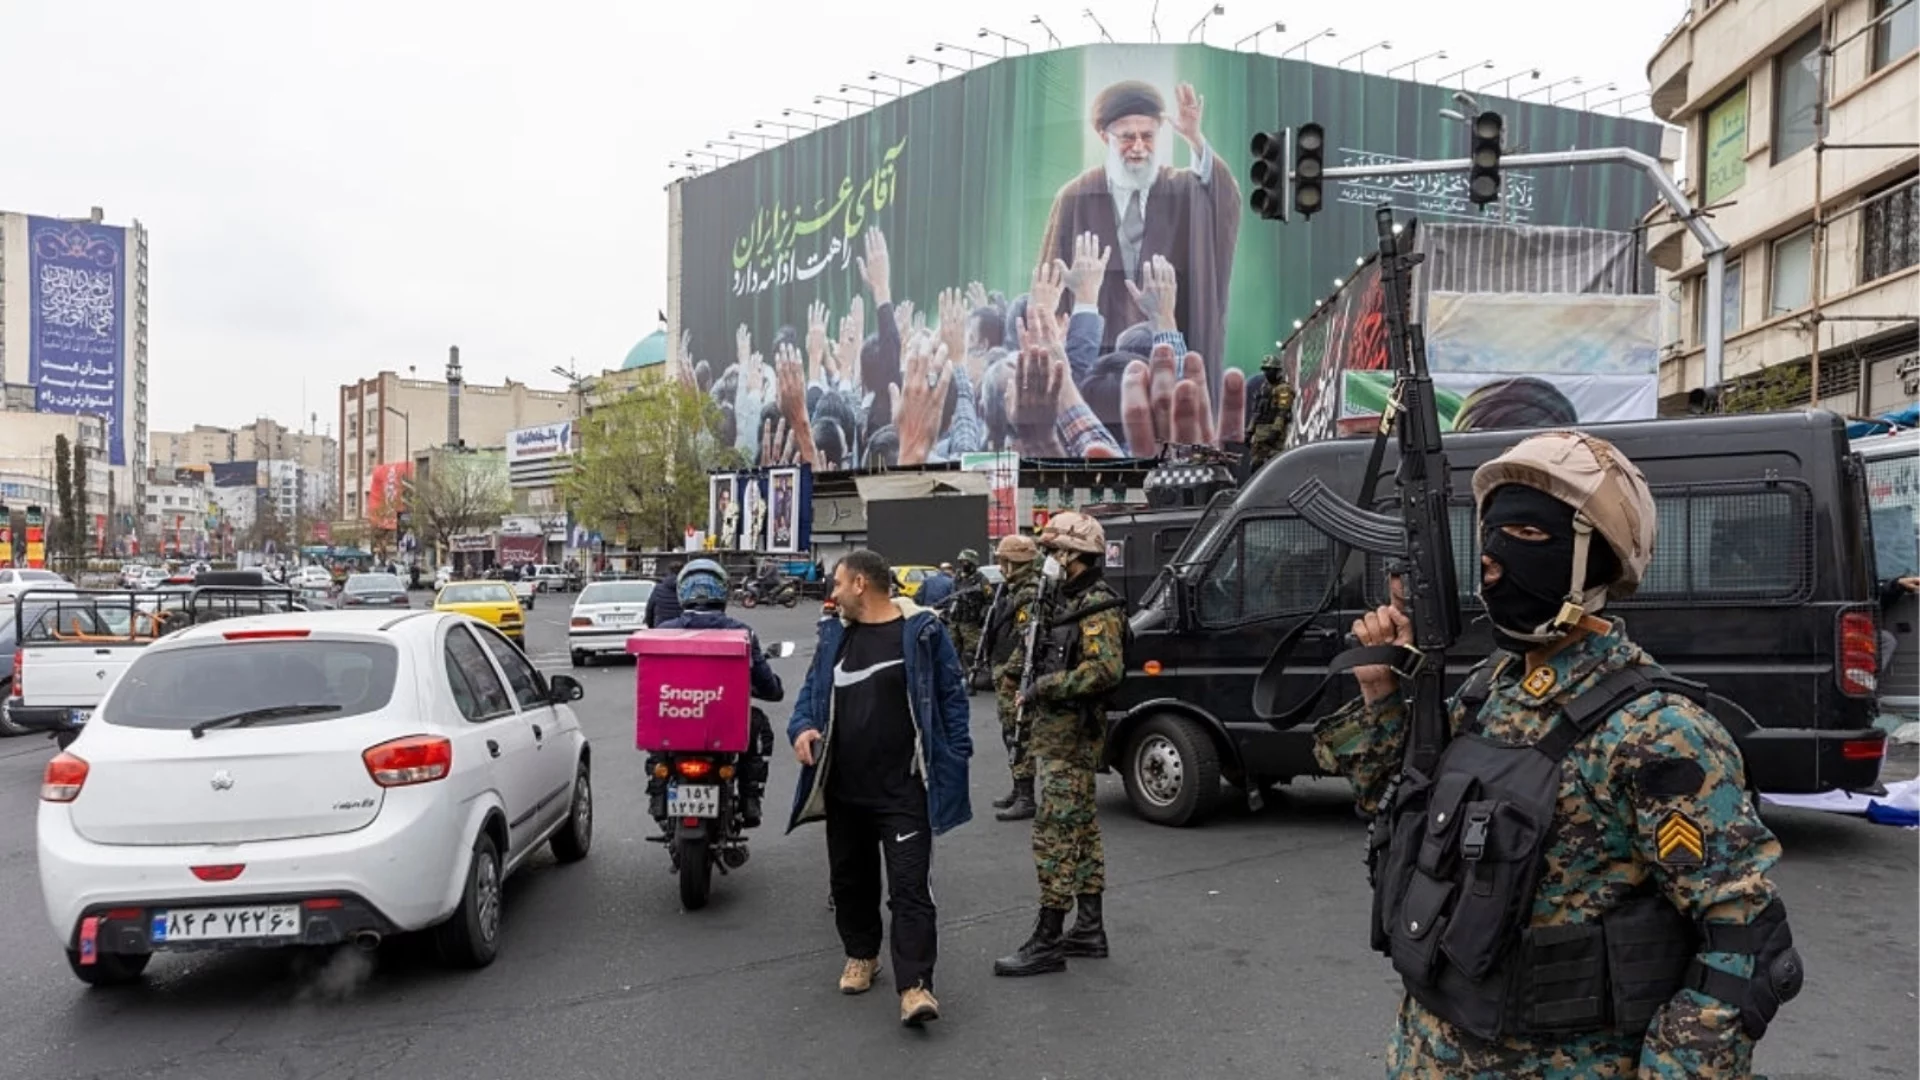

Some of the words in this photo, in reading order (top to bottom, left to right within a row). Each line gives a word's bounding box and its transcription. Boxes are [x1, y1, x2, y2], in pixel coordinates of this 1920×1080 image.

[845, 135, 908, 238] آقای
[732, 200, 780, 270] ایران
[775, 175, 854, 265] عزیز
[732, 260, 758, 298] دارد
[757, 248, 796, 293] ادامه
[796, 228, 851, 281] راهت
[658, 701, 704, 718] Food
[659, 684, 724, 704] Snapp!
